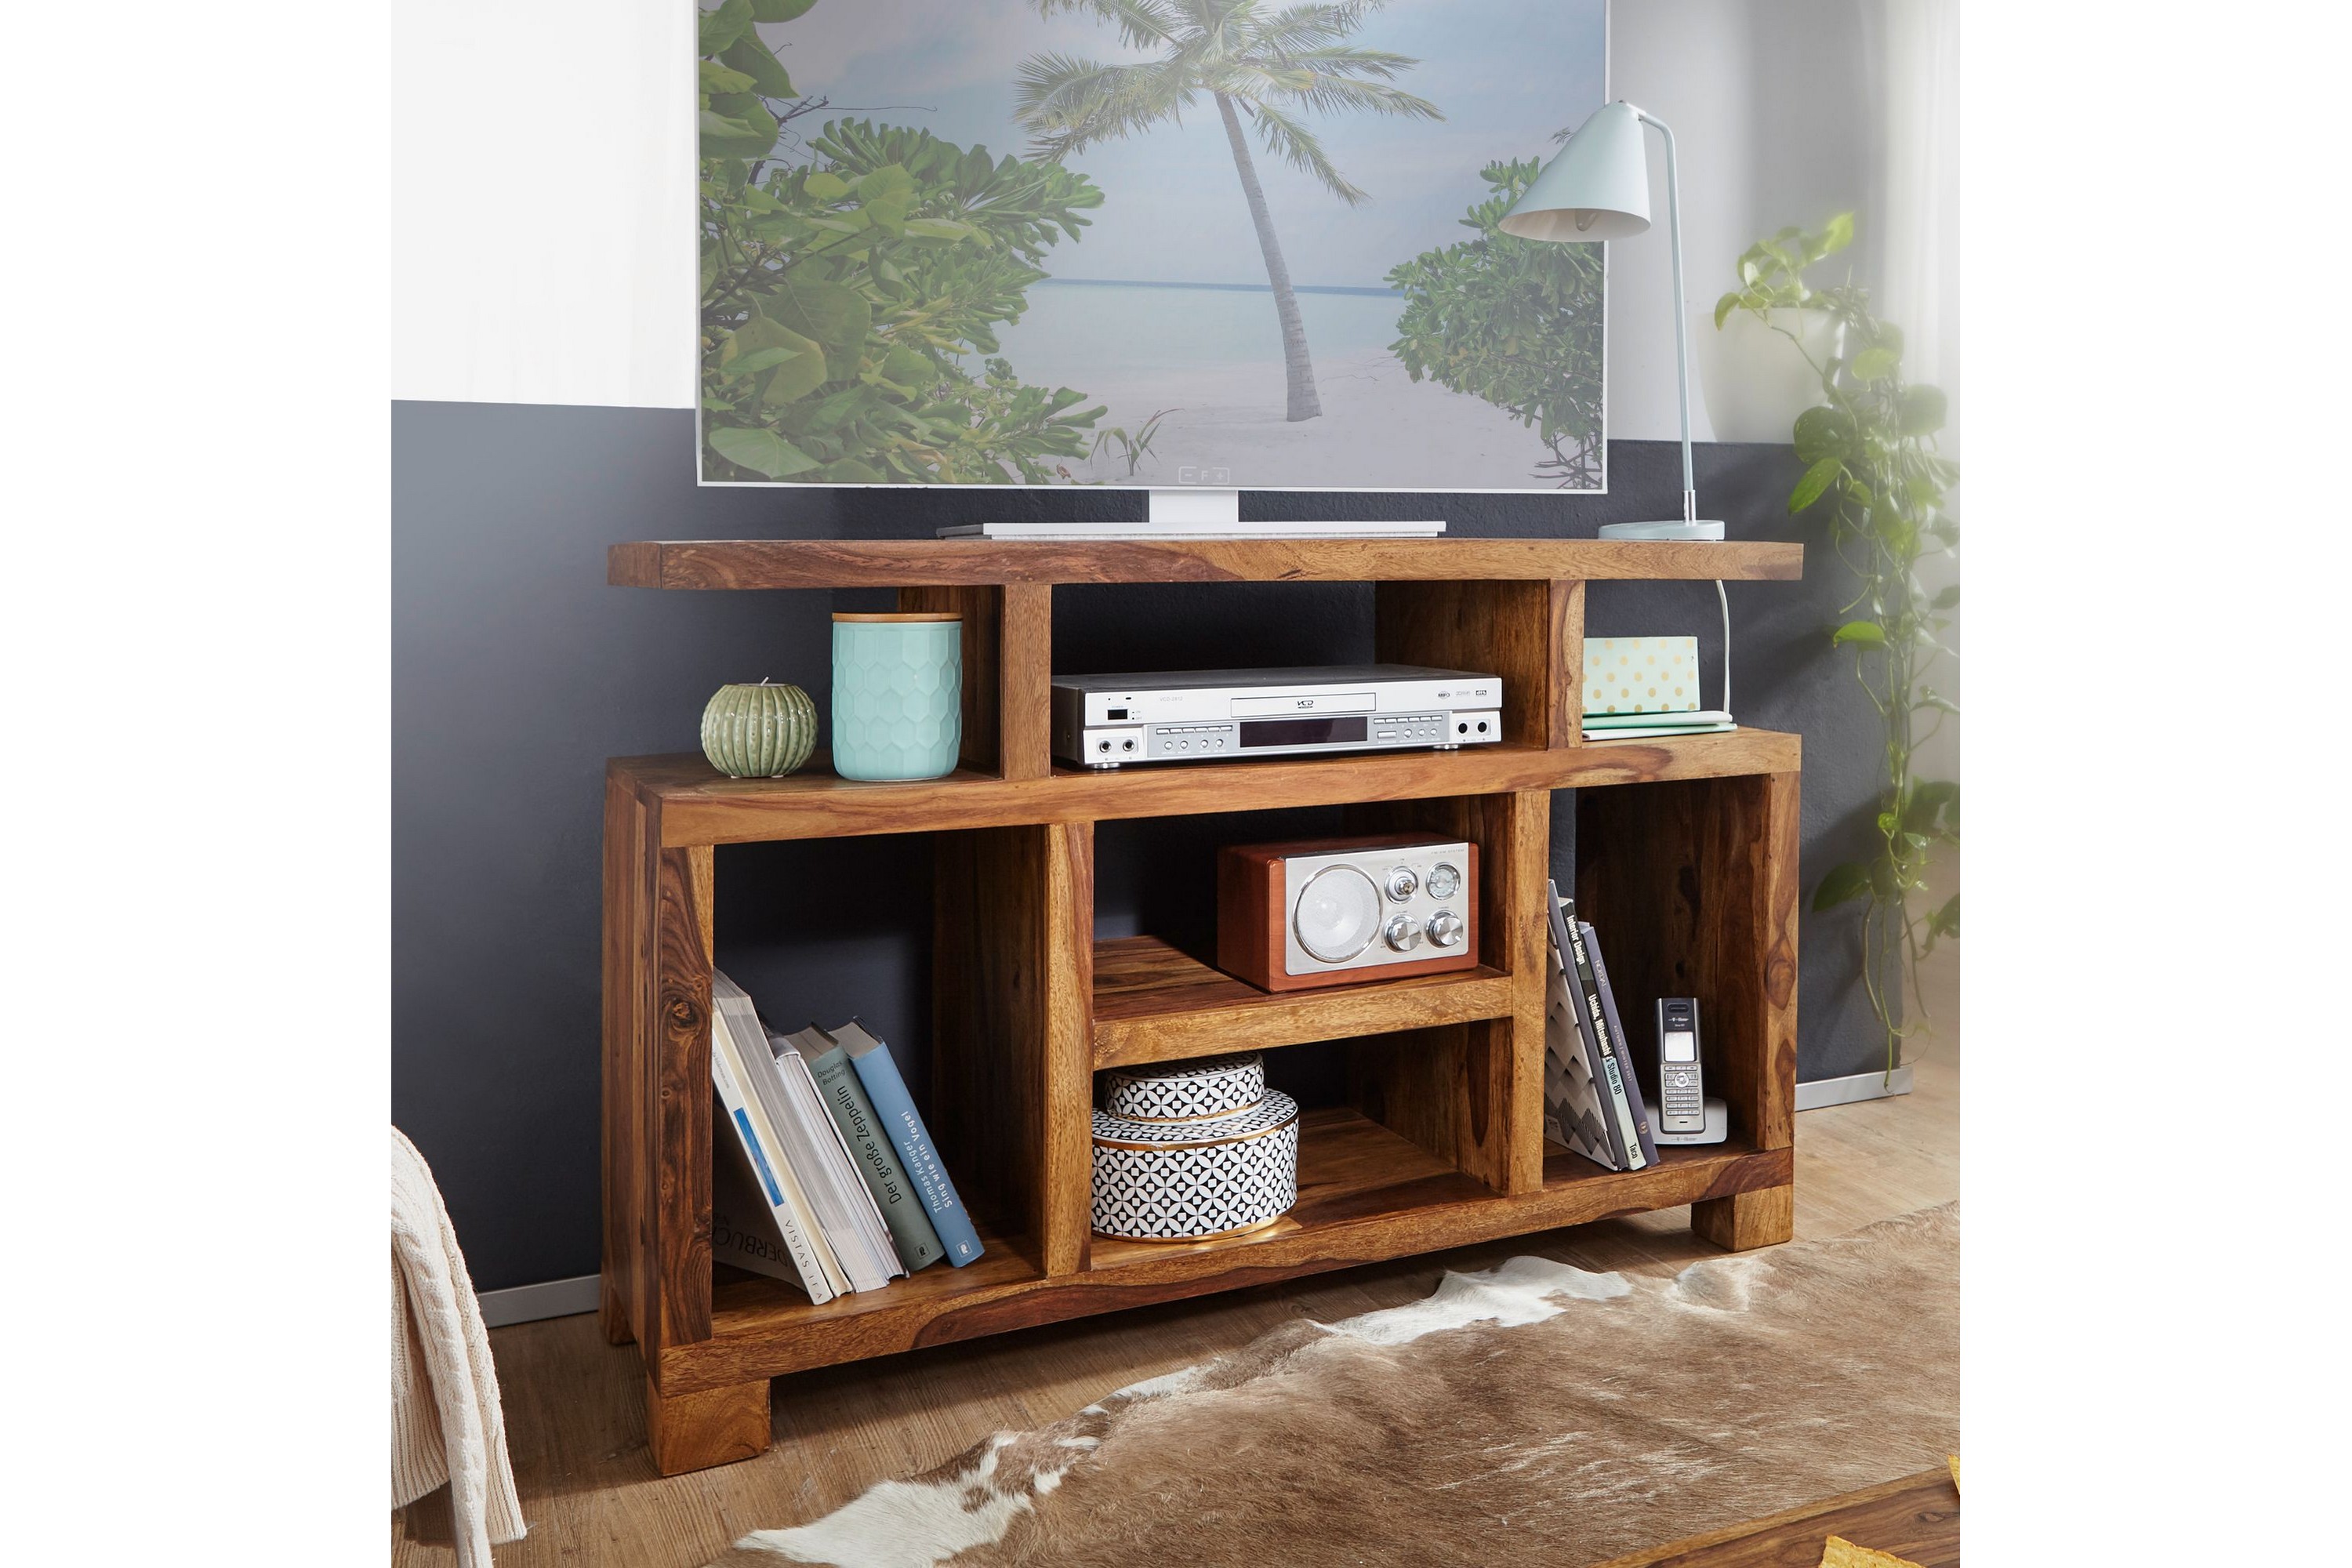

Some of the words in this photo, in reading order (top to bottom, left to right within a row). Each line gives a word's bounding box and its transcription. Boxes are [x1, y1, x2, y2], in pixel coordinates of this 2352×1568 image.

[1566, 914, 1579, 942] Interior
[1573, 941, 1585, 965] Design
[1588, 993, 1601, 1020] Uchida,
[1595, 1018, 1611, 1056] Mitsuhashi
[1607, 1062, 1619, 1085] Studio
[1613, 1084, 1622, 1095] 80
[817, 1061, 843, 1078] Douglas
[822, 1069, 845, 1086] Botting
[837, 1085, 870, 1142] Zeppelin
[901, 1111, 920, 1142] Vogel
[866, 1141, 892, 1179] große
[904, 1141, 925, 1175] Kanger
[919, 1143, 931, 1161] ein
[1629, 1142, 1638, 1159] Taco
[927, 1163, 941, 1182] wie
[884, 1181, 902, 1205] Der
[920, 1174, 942, 1214] Thomas
[938, 1182, 953, 1208] Sing
[785, 1219, 810, 1268] VISTAS
